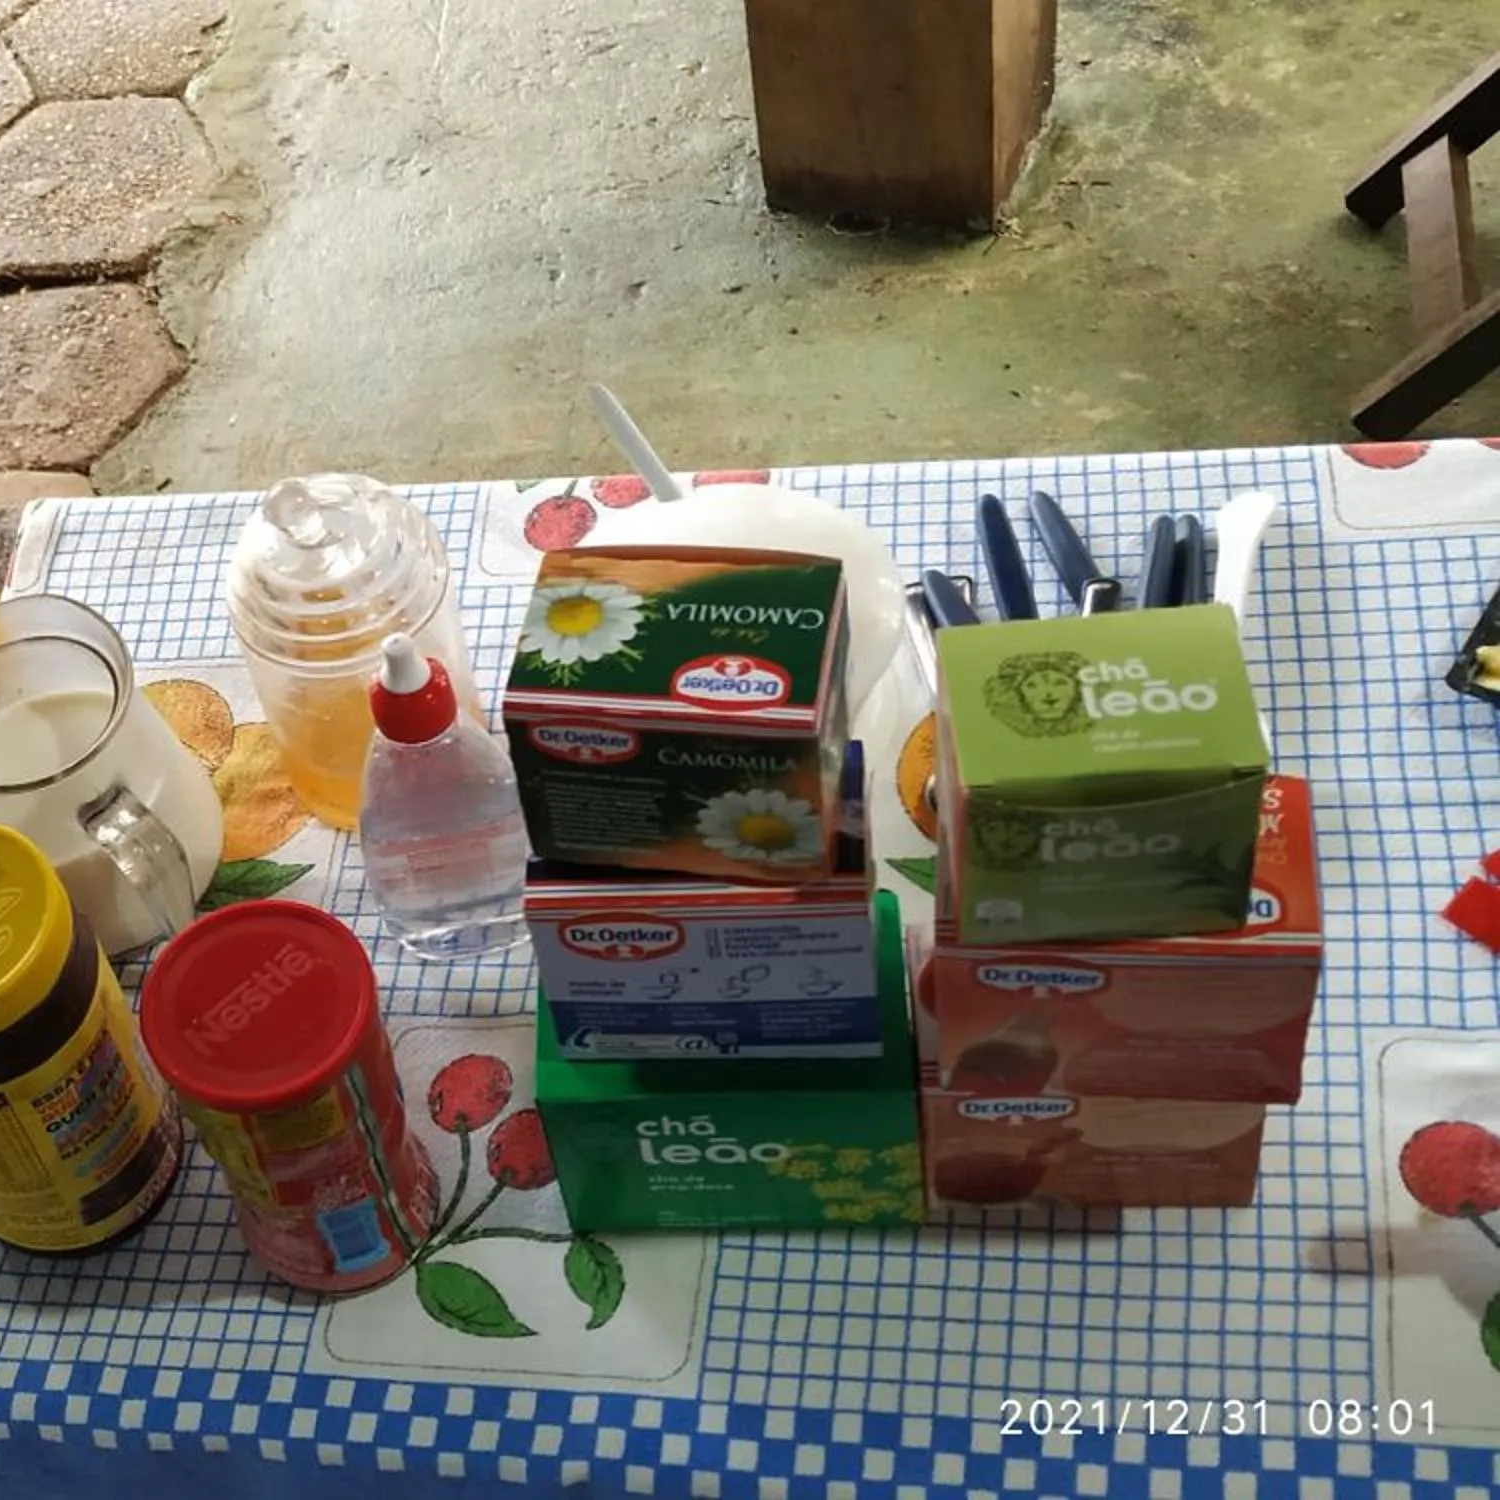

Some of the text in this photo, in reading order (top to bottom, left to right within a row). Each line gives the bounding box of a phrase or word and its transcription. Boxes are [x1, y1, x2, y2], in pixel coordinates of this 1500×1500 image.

[665, 602, 826, 630] CAMOMILA
[1076, 657, 1149, 684] chá
[1080, 678, 1219, 720] leão
[656, 748, 798, 772] CAMOMILA
[635, 1114, 717, 1137] chá
[638, 1137, 792, 1166] leão
